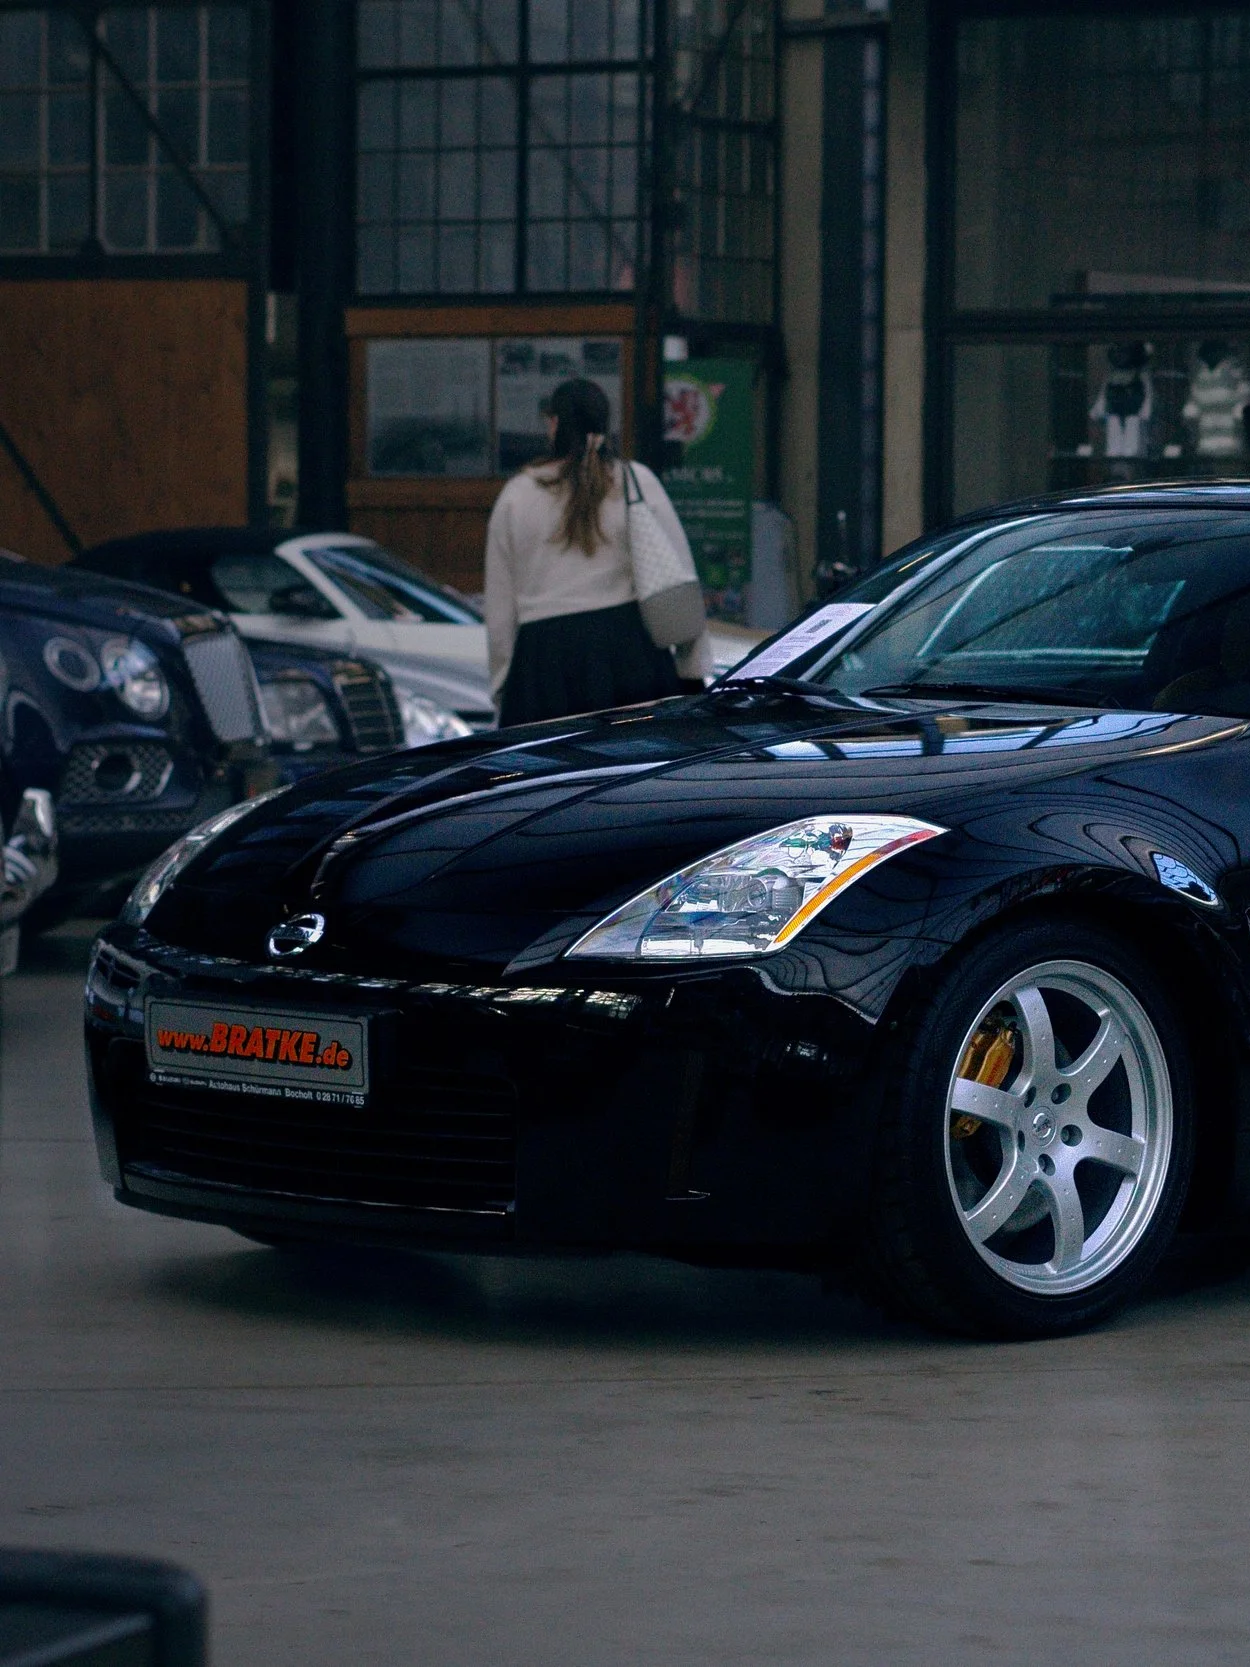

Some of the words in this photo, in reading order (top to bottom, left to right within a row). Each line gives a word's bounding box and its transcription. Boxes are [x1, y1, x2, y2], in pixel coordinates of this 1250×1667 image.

[156, 1022, 353, 1070] www.BRATKE.de
[208, 1079, 241, 1092] Autohaus
[284, 1087, 313, 1100] Bocholt
